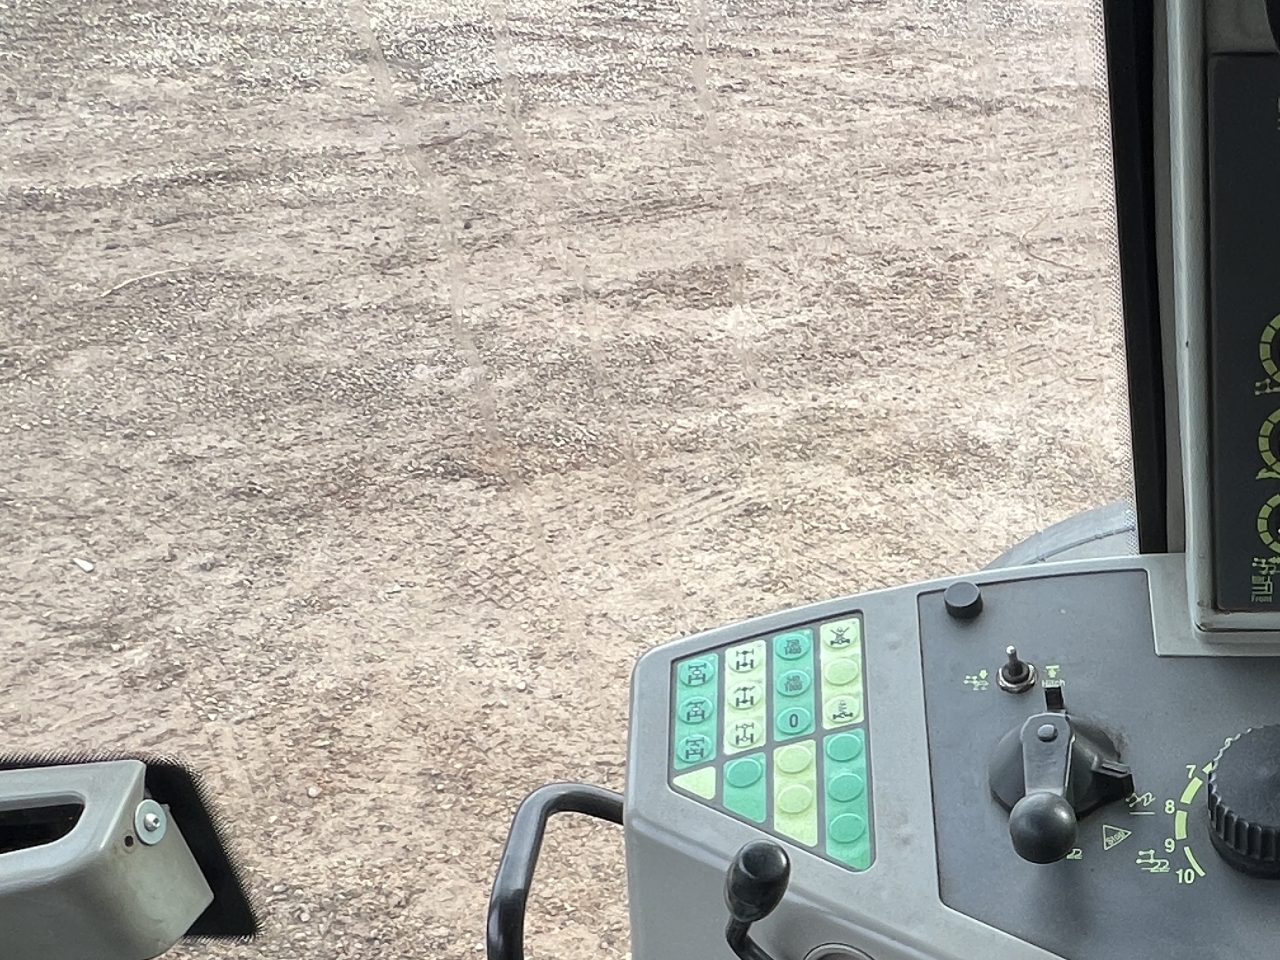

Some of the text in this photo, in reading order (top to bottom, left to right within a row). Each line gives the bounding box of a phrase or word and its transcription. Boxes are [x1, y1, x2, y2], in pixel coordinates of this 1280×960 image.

[789, 713, 798, 728] 0
[1186, 764, 1197, 779] 7
[1164, 800, 1175, 814] 8
[1164, 838, 1175, 853] 9
[1175, 869, 1195, 884] 10
